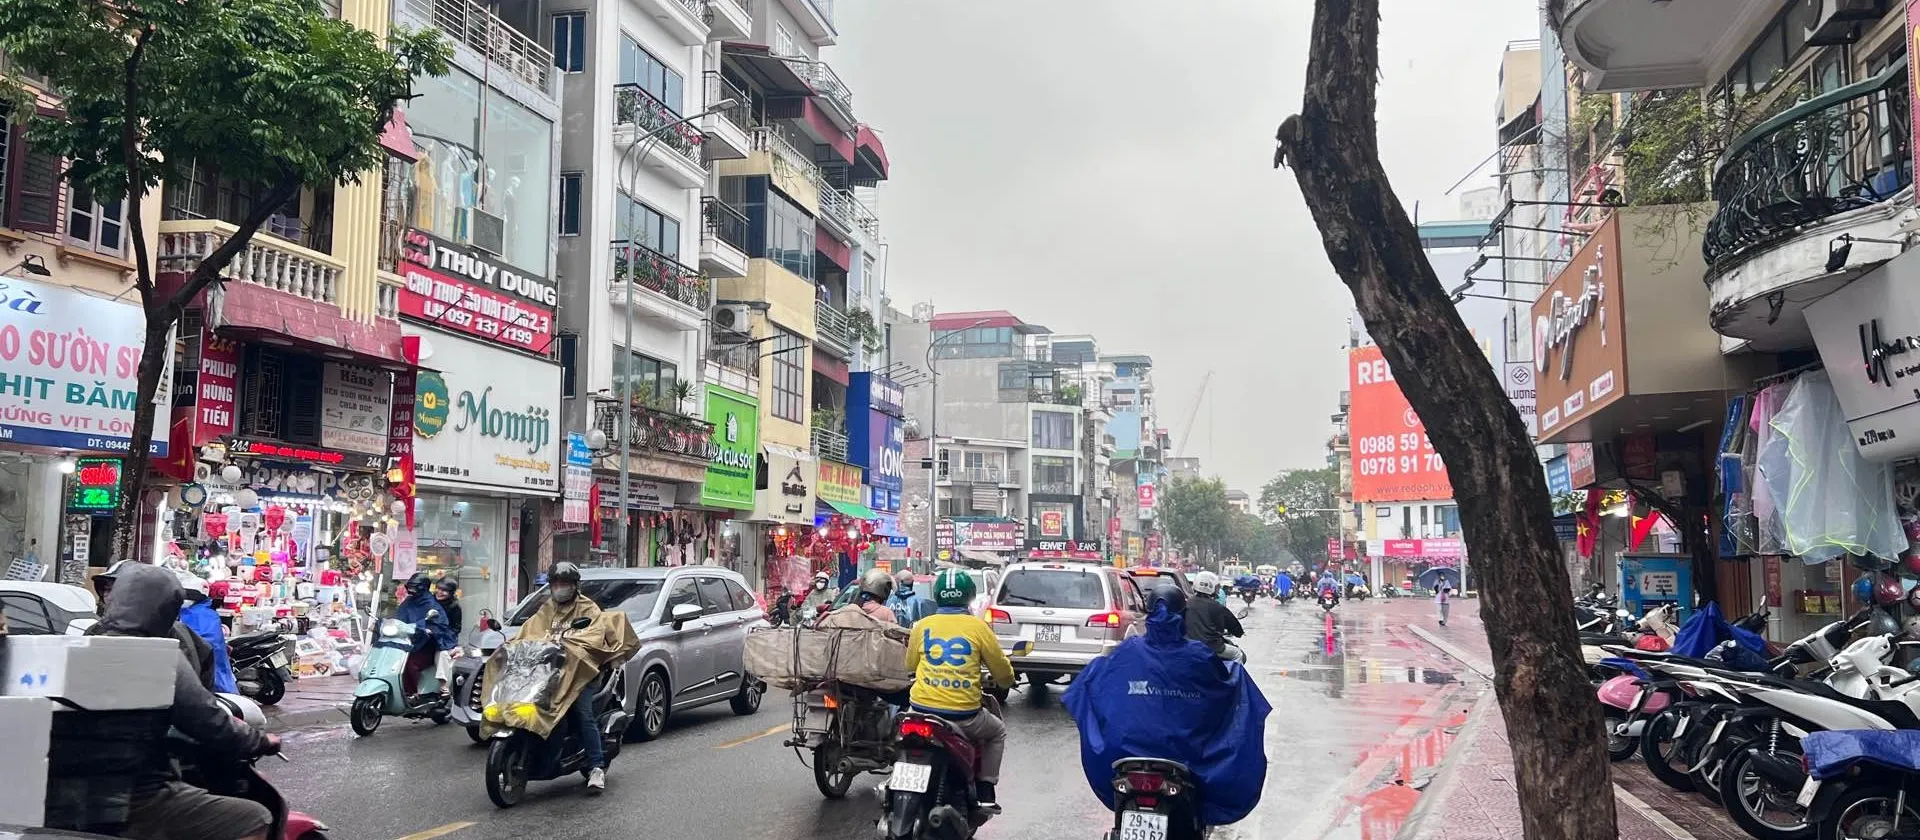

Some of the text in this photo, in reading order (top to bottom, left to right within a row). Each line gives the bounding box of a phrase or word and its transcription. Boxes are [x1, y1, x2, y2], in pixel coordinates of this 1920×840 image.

[408, 271, 433, 297] CHO
[437, 246, 557, 307] THÙY DUNG
[449, 309, 473, 327] 097
[475, 317, 499, 335] 131
[28, 327, 110, 376] SƯỜN
[202, 358, 236, 379] PHILIP
[65, 380, 137, 412] BĂM
[203, 380, 233, 402] HÙNG
[60, 414, 91, 431] VỊT
[203, 405, 229, 427] TIẾN
[455, 386, 550, 455] Momiji
[393, 422, 409, 437] CẤP
[231, 439, 249, 452] 244
[389, 442, 410, 453] 244
[1359, 435, 1396, 455] 0988
[1400, 433, 1419, 451] 59
[367, 457, 382, 468] 244
[1360, 453, 1443, 475] 0978 91 70
[1040, 541, 1097, 551] GENVIET JEANS
[940, 589, 963, 599] Grab
[923, 628, 972, 666] be
